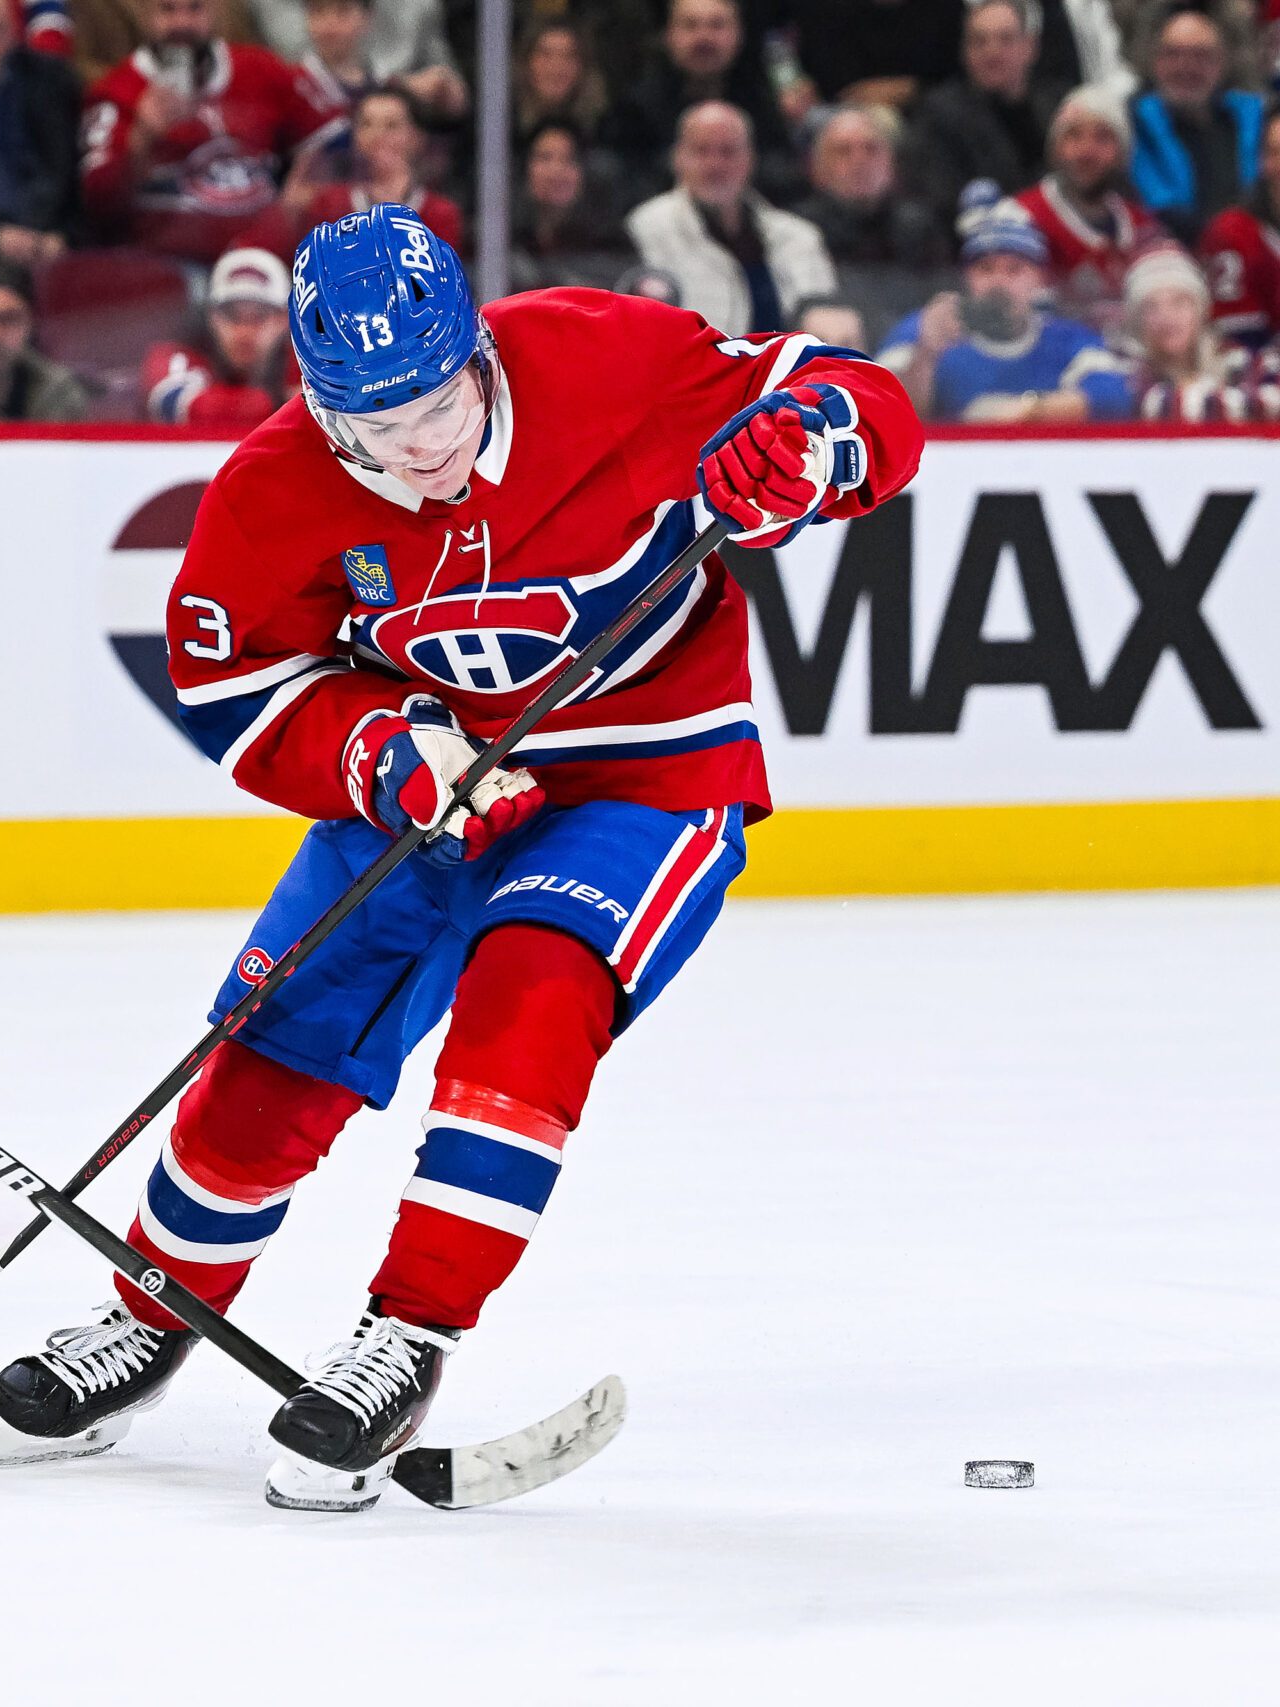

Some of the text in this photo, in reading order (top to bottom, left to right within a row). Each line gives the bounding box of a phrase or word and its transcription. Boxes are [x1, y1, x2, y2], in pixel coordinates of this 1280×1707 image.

[390, 217, 435, 273] Bell
[292, 245, 318, 318] Bell
[357, 315, 395, 353] 13
[361, 368, 419, 394] BAUER
[357, 587, 391, 601] RBC
[718, 488, 1266, 736] MAX
[179, 593, 234, 662] 3
[486, 875, 630, 924] BAUER
[97, 1119, 140, 1168] BAUER
[381, 1415, 412, 1452] BAUER
